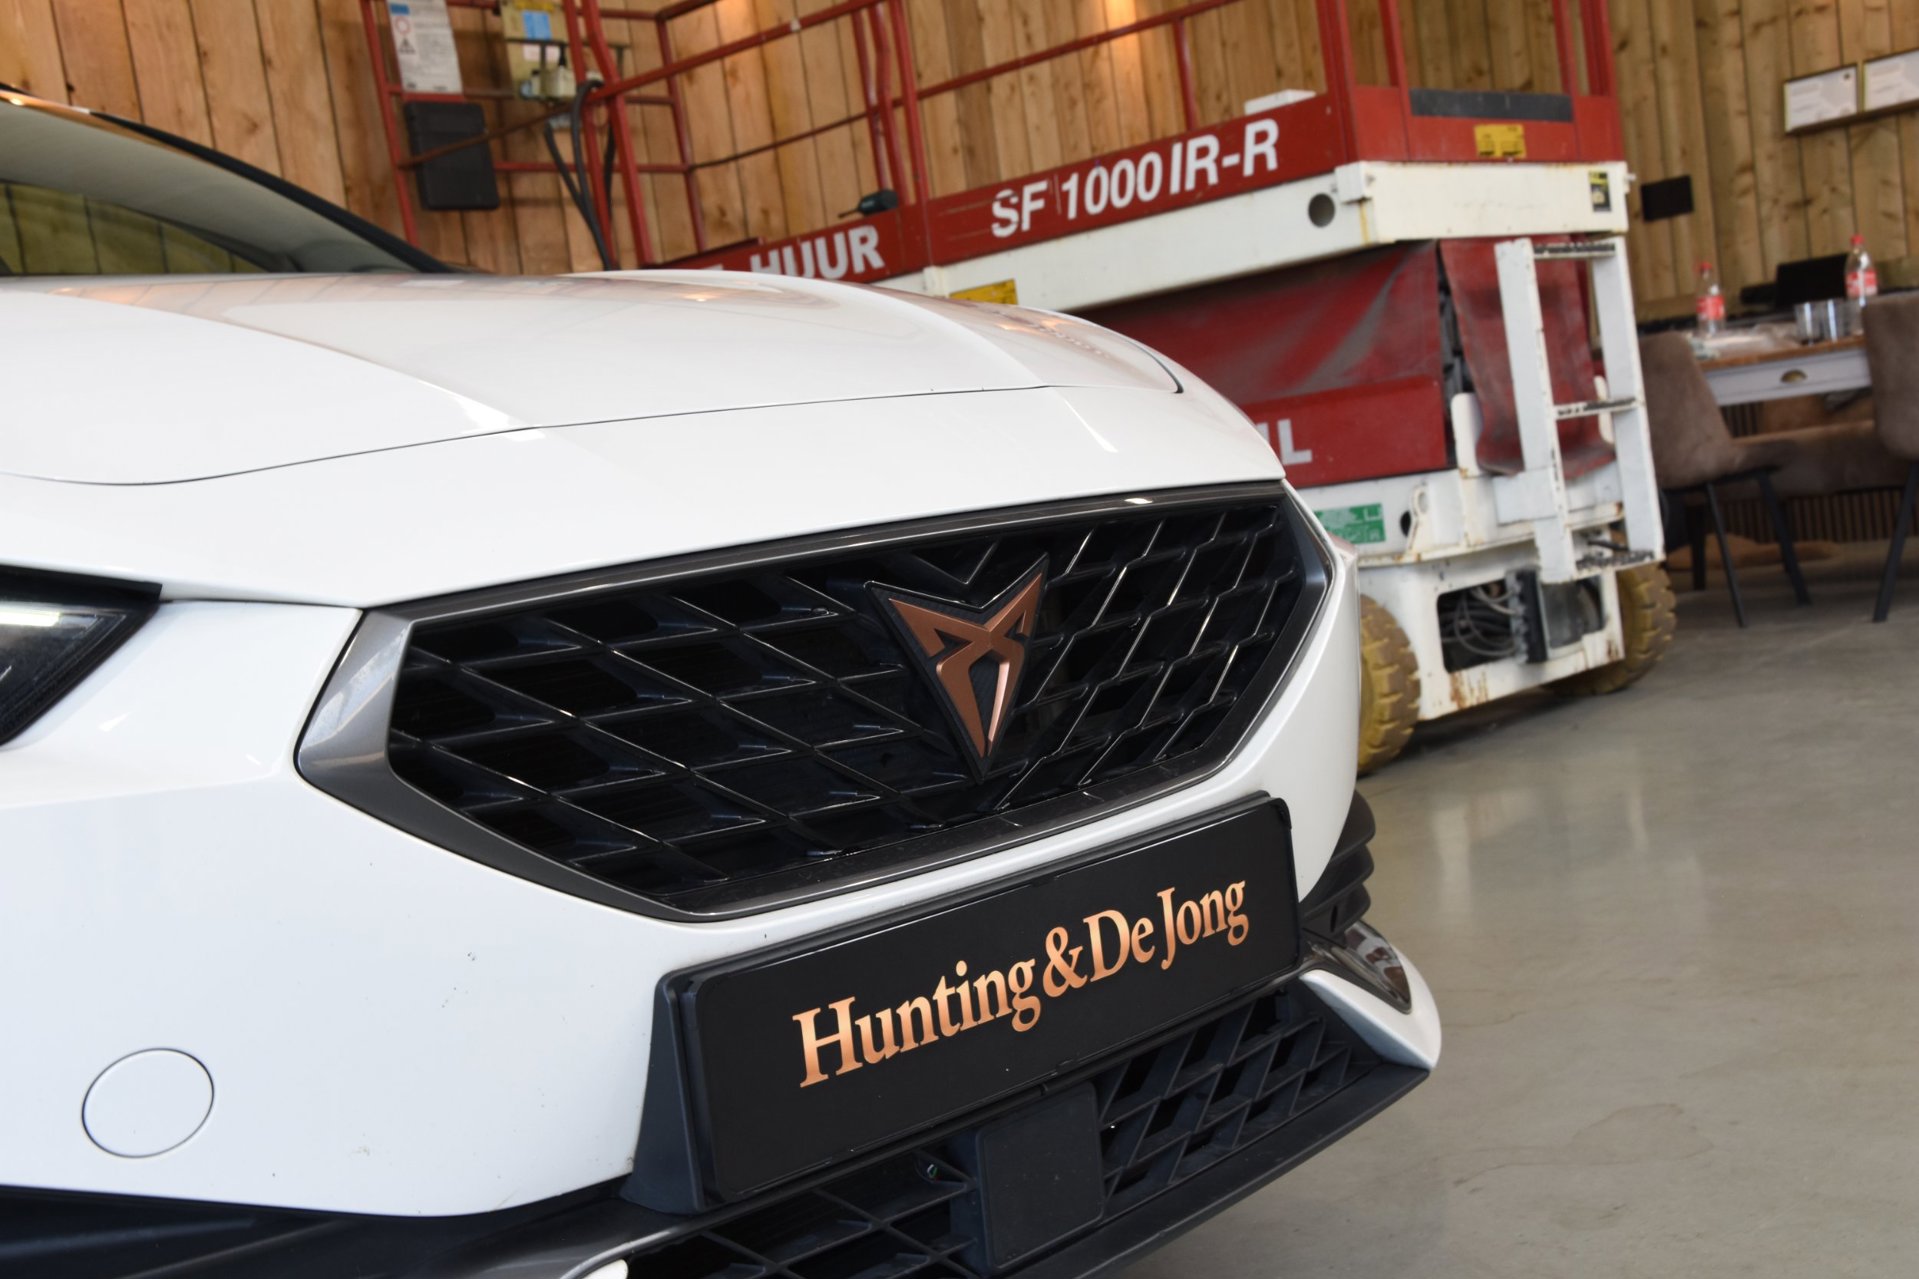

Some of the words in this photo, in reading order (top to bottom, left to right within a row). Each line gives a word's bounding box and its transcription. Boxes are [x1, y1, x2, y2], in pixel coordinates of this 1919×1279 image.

[991, 180, 1049, 238] SF
[1061, 151, 1163, 220] 1000
[792, 958, 1042, 1088] Hunting
[1156, 880, 1249, 970] Jong
